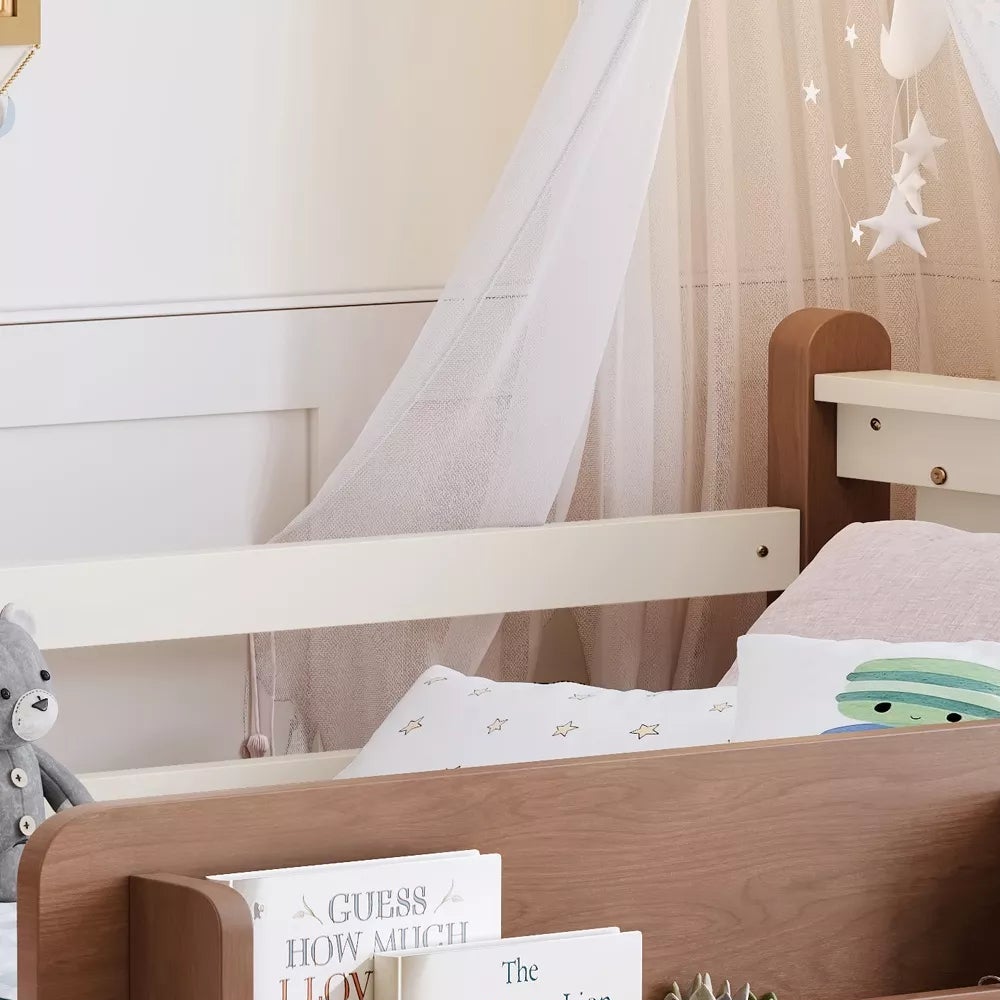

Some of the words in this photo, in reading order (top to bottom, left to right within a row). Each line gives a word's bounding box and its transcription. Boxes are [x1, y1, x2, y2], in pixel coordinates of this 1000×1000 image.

[328, 885, 428, 924] GUESS
[285, 931, 364, 969] HOW
[373, 921, 469, 953] MUCH
[501, 957, 539, 984] The
